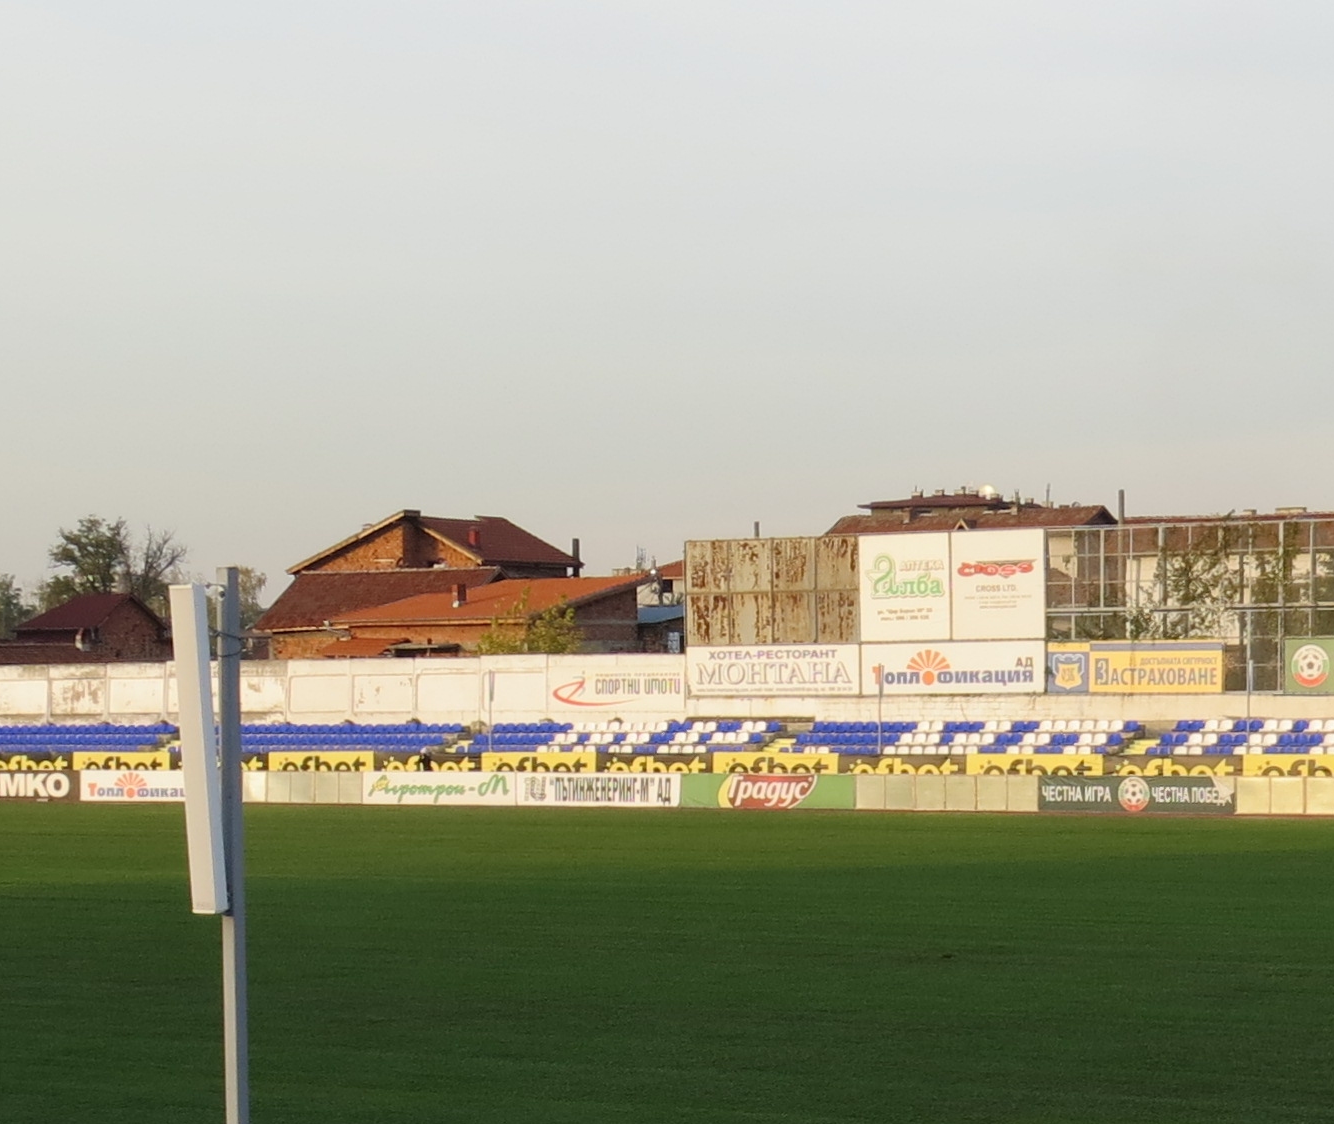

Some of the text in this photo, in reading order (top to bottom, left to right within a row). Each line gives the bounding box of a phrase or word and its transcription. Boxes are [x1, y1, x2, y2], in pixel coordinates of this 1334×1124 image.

[708, 650, 837, 660] ХОТЕЛ-РЕСТОРАНТ
[1016, 657, 1034, 668] АД
[696, 661, 852, 685] МОНТАНА
[657, 777, 671, 803] АД
[728, 775, 810, 807] Градус
[1042, 785, 1111, 802] ЧЕСТНА ИГРА
[1152, 786, 1190, 803] ЧЕСТНА
